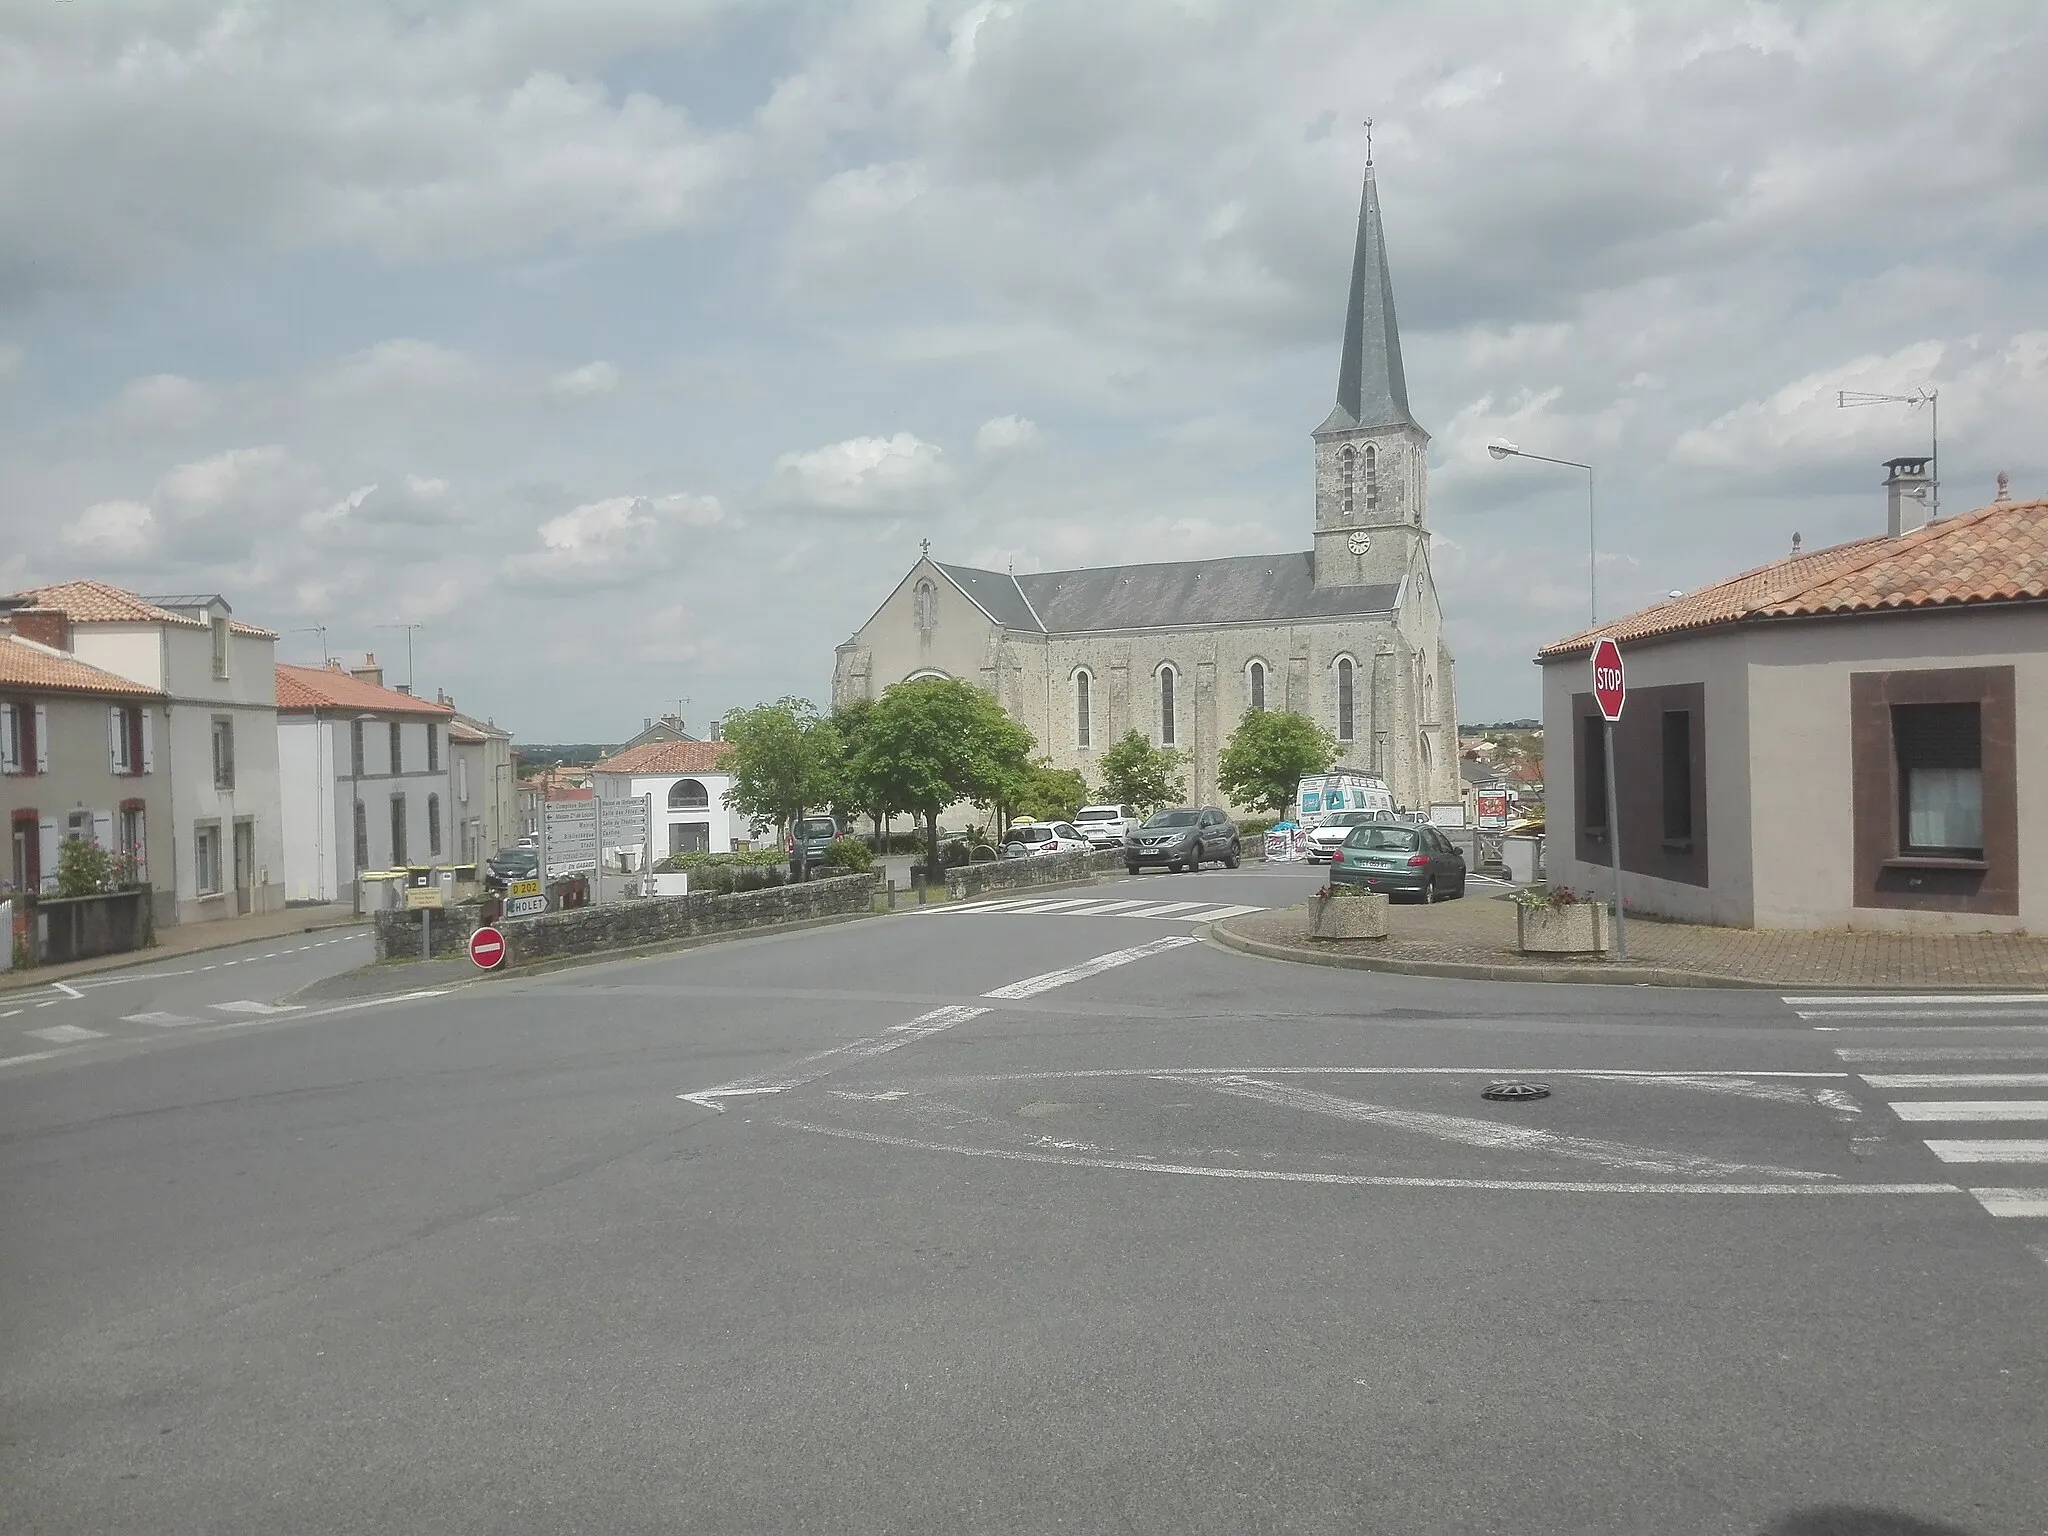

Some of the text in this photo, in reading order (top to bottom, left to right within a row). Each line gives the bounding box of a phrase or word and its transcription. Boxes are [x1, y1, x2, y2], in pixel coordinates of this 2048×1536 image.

[1597, 667, 1621, 691] STOP
[513, 882, 537, 894] D 202
[510, 899, 543, 913] HOLET
